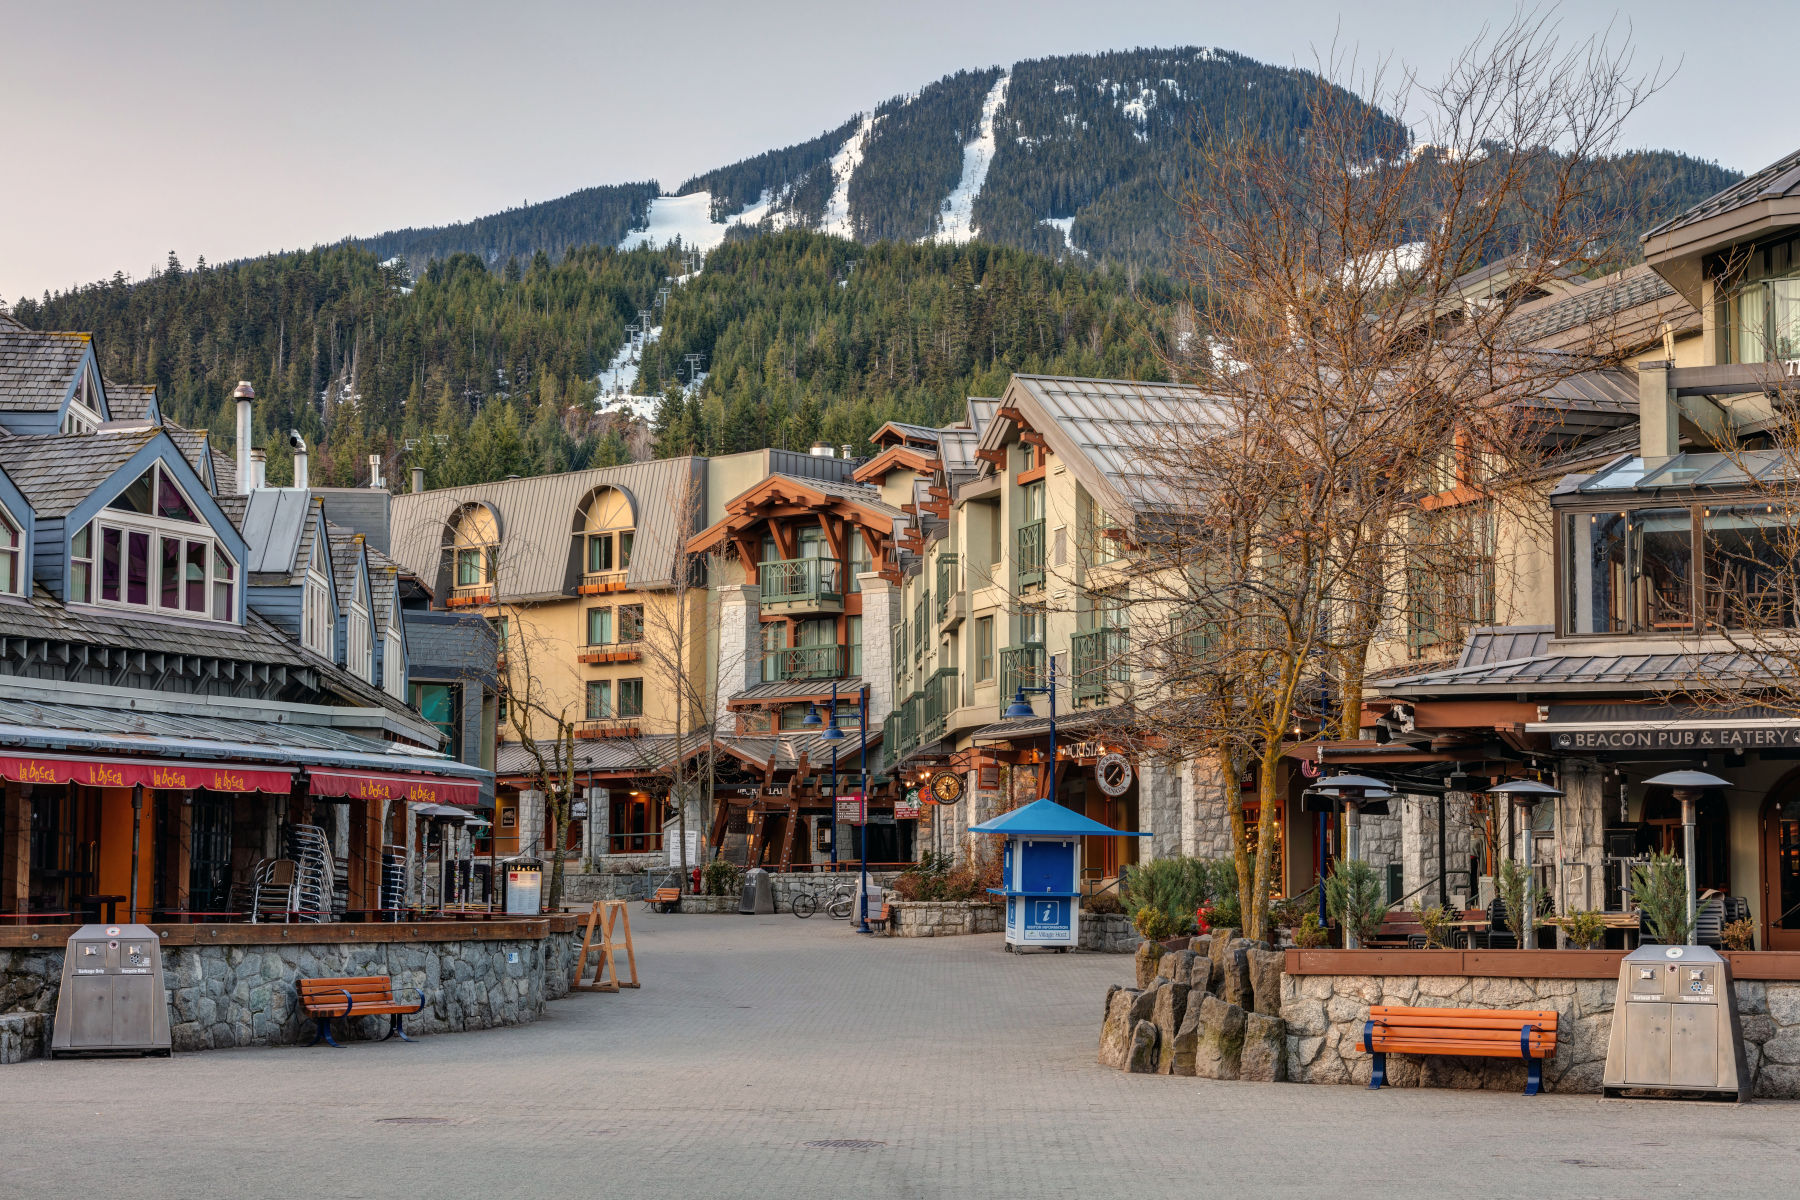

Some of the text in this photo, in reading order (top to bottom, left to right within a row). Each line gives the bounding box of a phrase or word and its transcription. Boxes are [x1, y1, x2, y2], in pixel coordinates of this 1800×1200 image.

[1576, 730, 1788, 747] BEACON PUB & EATERY
[20, 761, 57, 783] la bocca
[98, 764, 124, 786] bocca
[153, 768, 187, 788] la bocca
[215, 770, 245, 790] la bocca
[360, 780, 390, 798] la bocca
[418, 784, 436, 802] bocca
